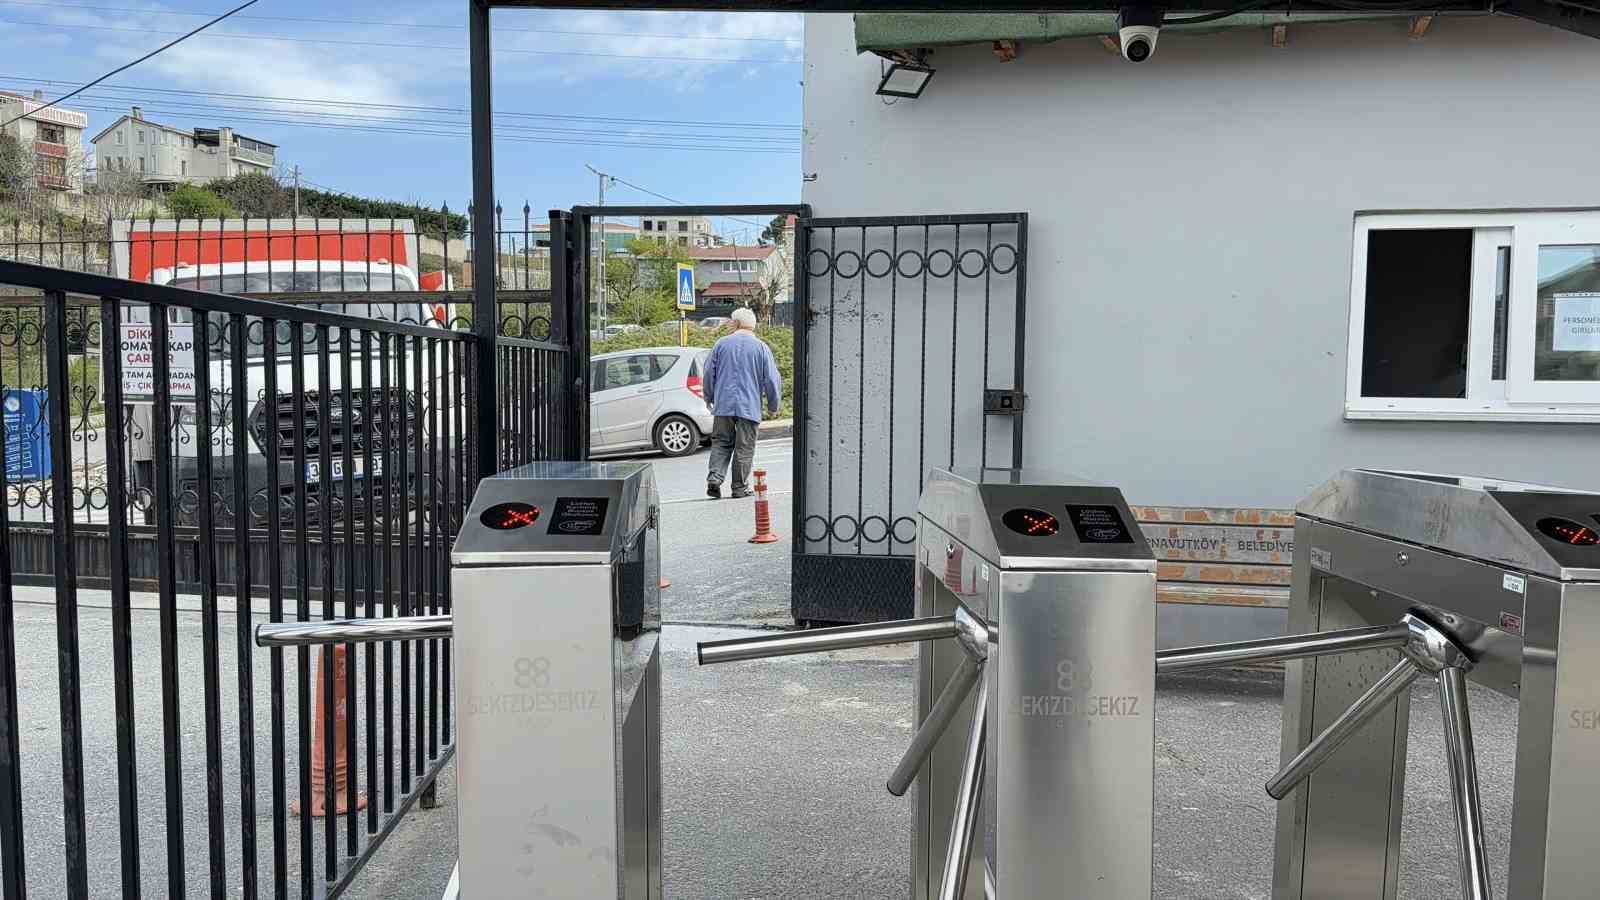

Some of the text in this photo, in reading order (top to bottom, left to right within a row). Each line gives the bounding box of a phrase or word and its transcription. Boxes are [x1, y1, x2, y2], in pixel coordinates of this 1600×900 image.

[128, 329, 173, 339] DİKK!
[121, 341, 192, 351] OMAT KAP
[127, 353, 173, 365] ÇARR
[1146, 537, 1217, 550] NAVUTKÖY
